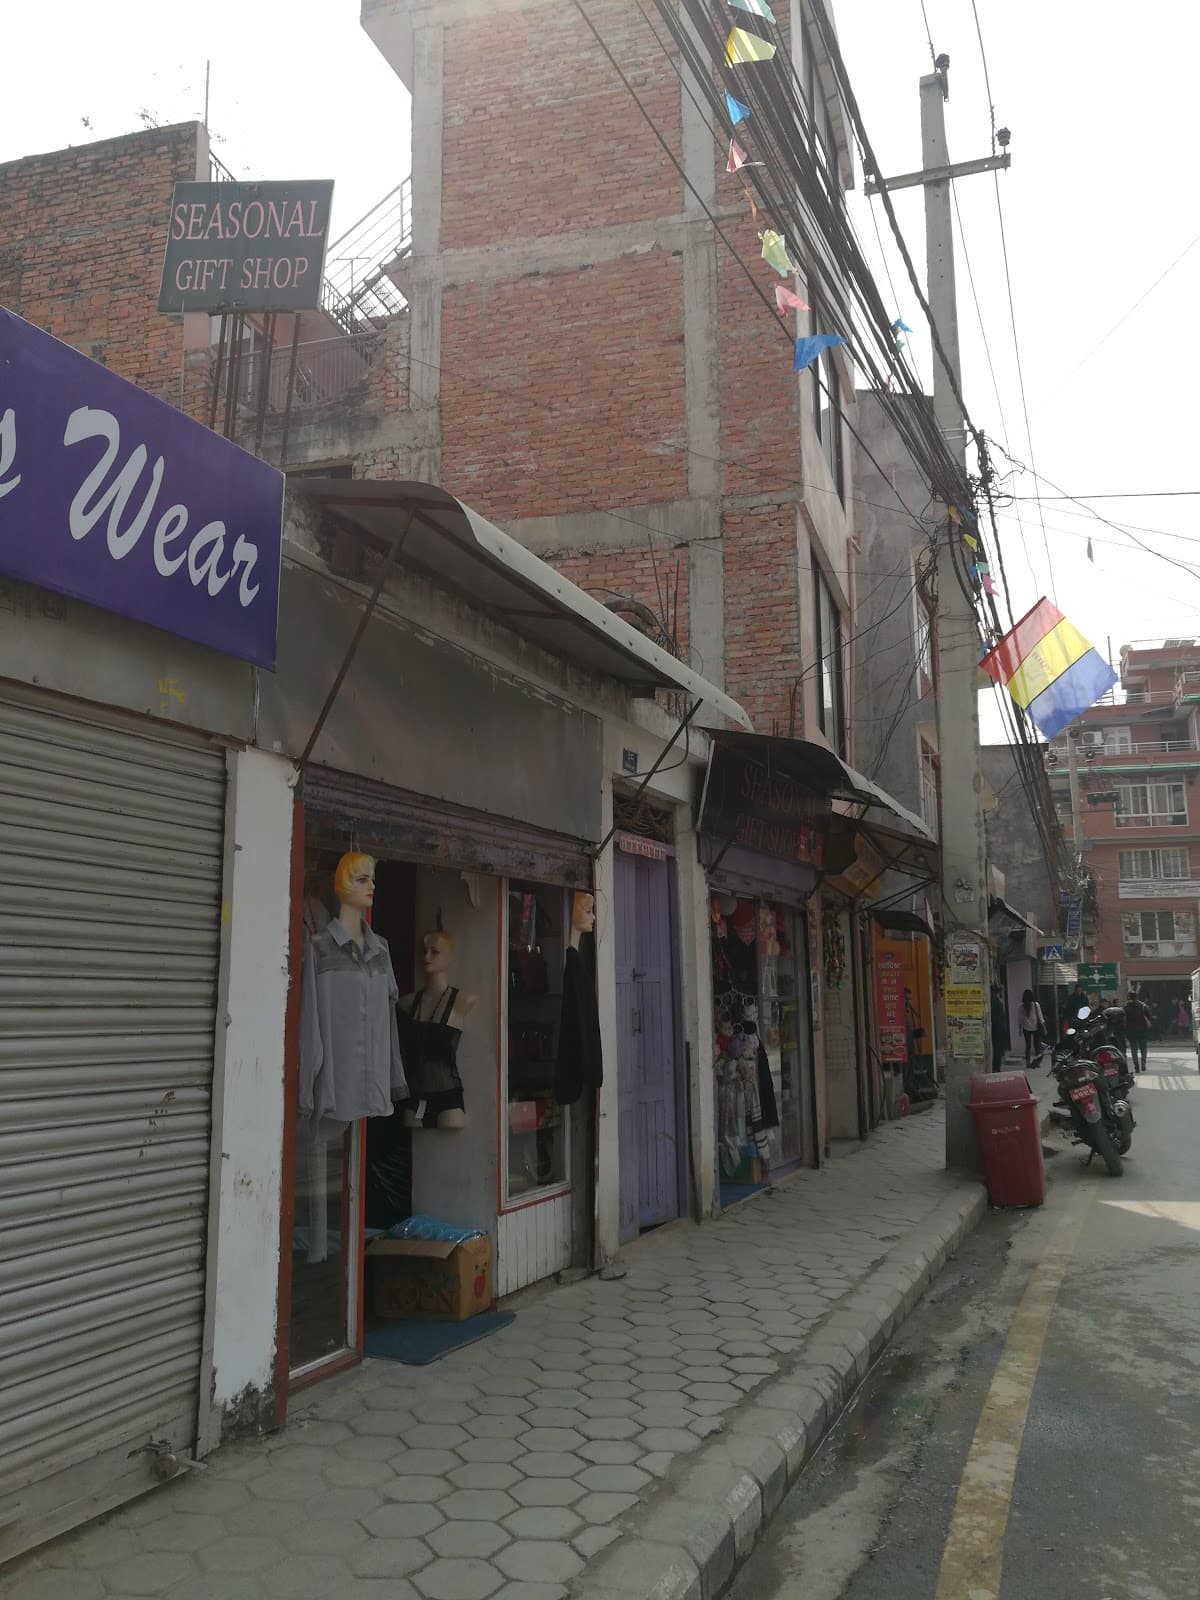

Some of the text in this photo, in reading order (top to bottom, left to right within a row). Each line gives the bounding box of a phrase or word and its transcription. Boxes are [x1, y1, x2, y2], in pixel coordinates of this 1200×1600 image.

[171, 200, 323, 241] SEASONAL
[175, 257, 309, 291] GIFT SHOP
[64, 405, 260, 607] Wear
